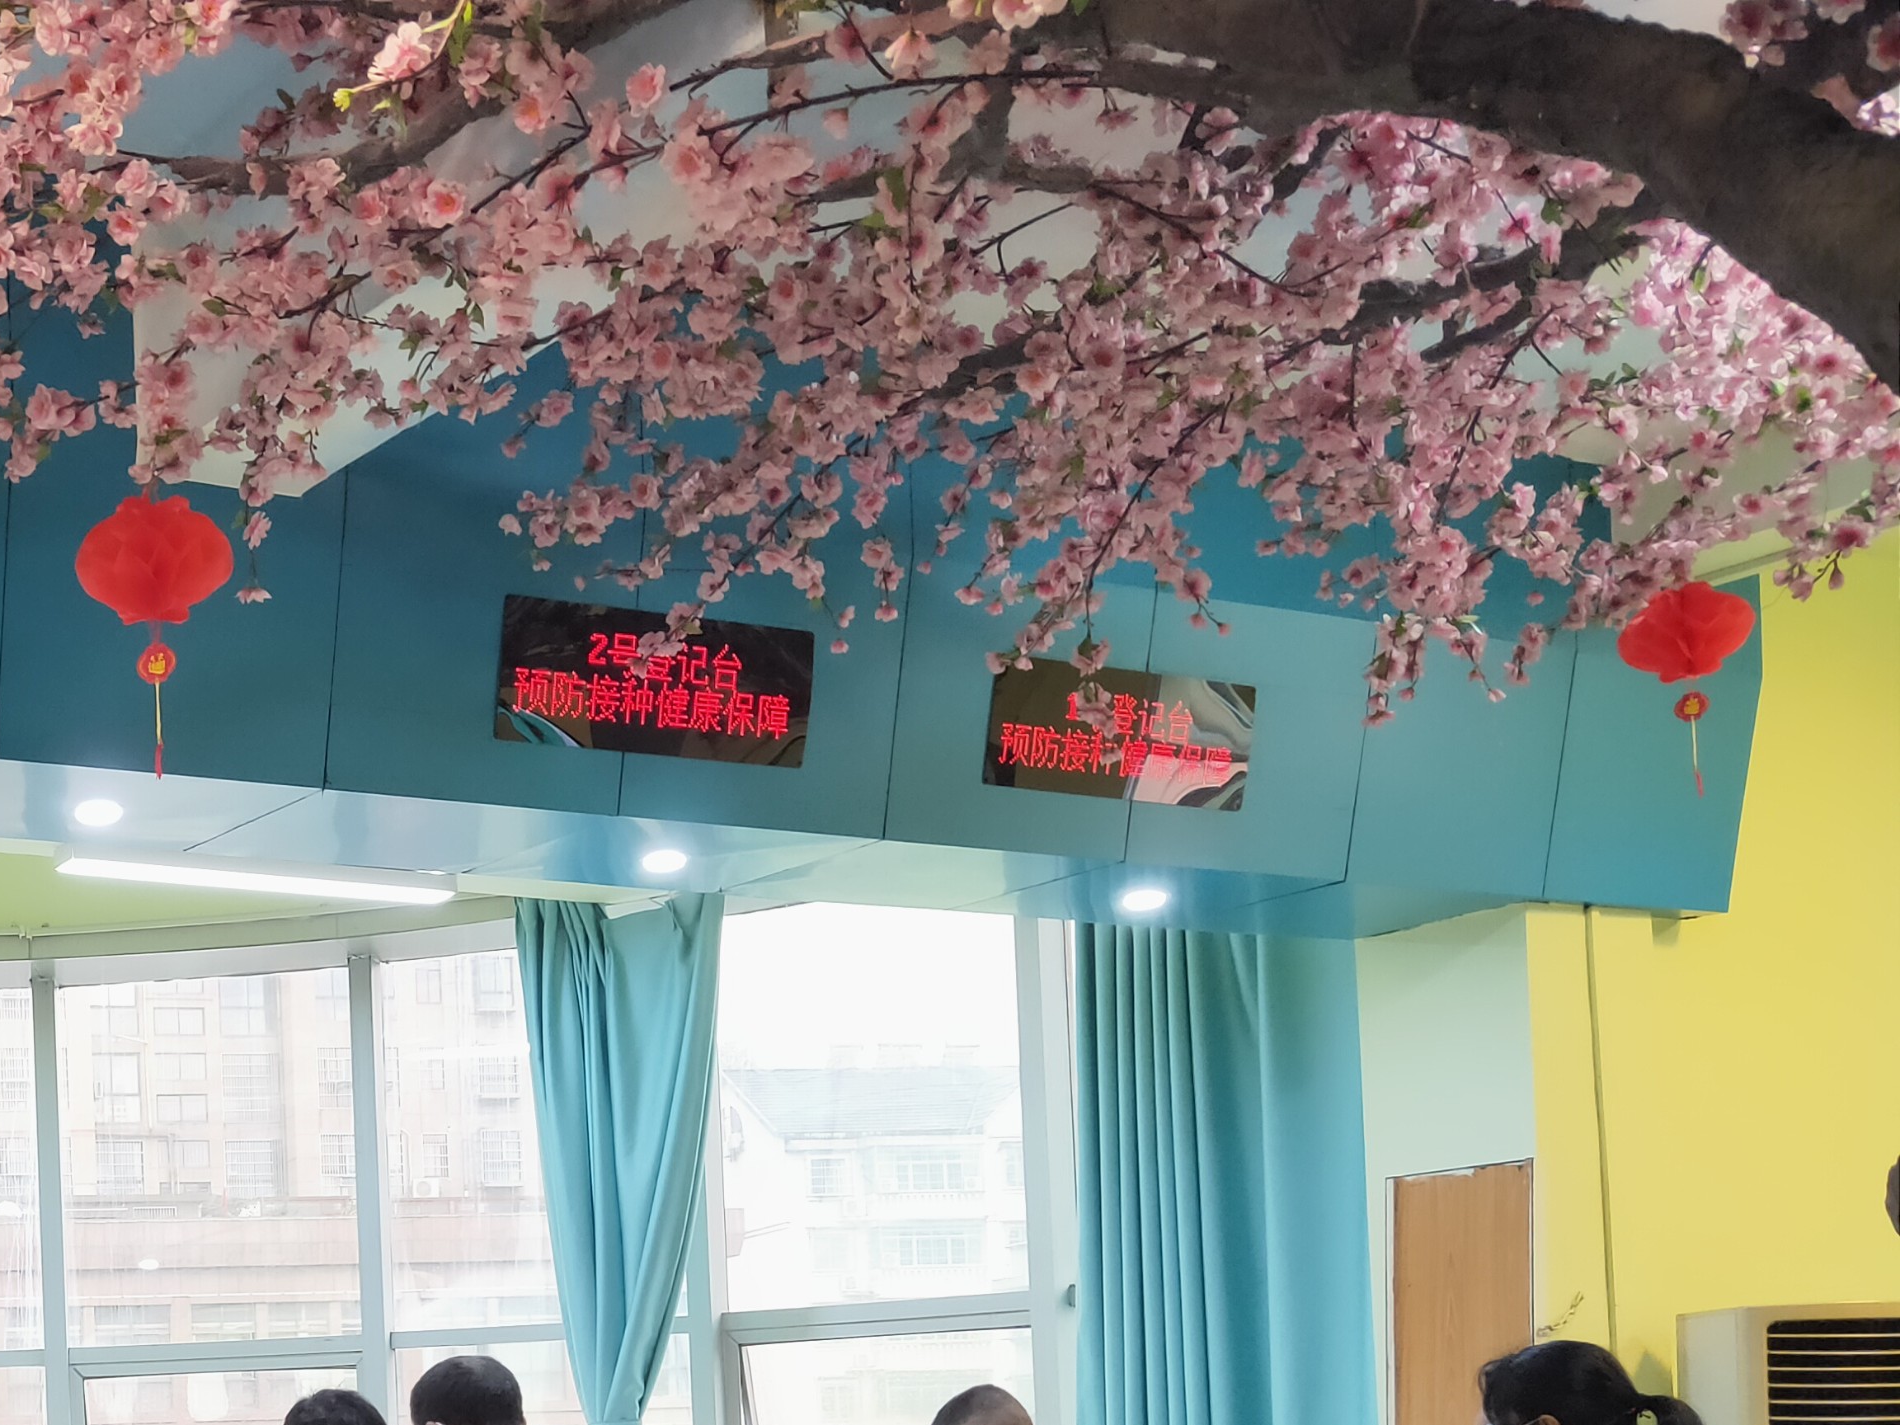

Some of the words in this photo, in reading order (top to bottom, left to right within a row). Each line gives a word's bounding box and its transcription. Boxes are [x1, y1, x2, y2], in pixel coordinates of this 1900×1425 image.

[512, 667, 791, 740] 预防接种健康保障
[1065, 692, 1193, 745] 1登记台
[997, 722, 1233, 786] 预防接种健康保障
